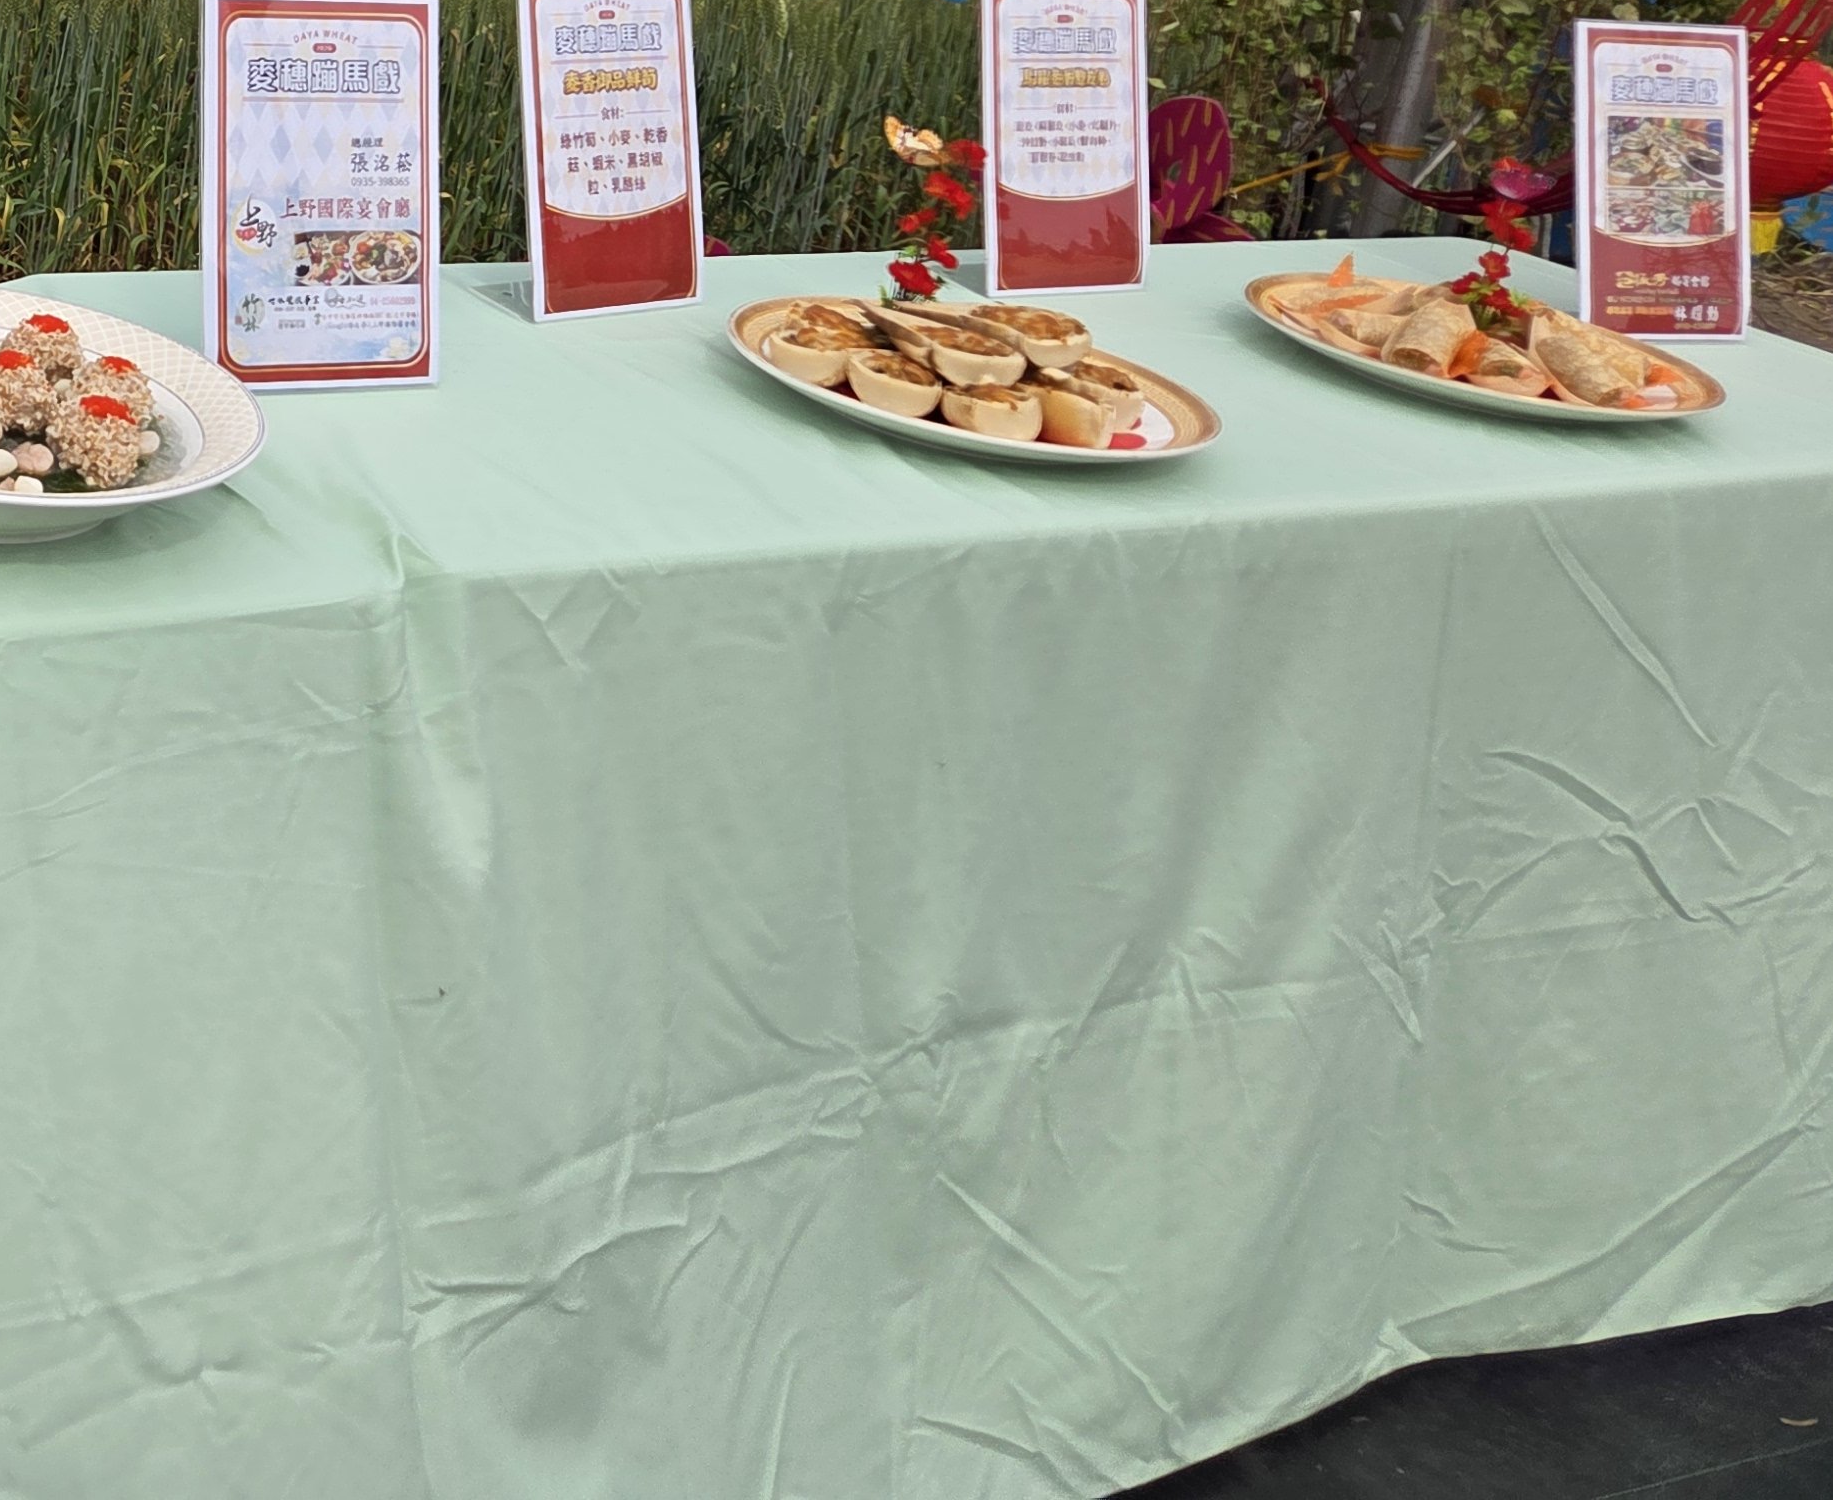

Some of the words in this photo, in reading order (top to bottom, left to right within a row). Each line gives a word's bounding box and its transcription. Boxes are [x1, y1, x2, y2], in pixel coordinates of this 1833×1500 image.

[293, 30, 319, 44] DAYA
[323, 30, 358, 45] WHEAT
[246, 58, 401, 95] 麥穗蹦馬戲
[280, 197, 411, 220] 上野國際宴會廳
